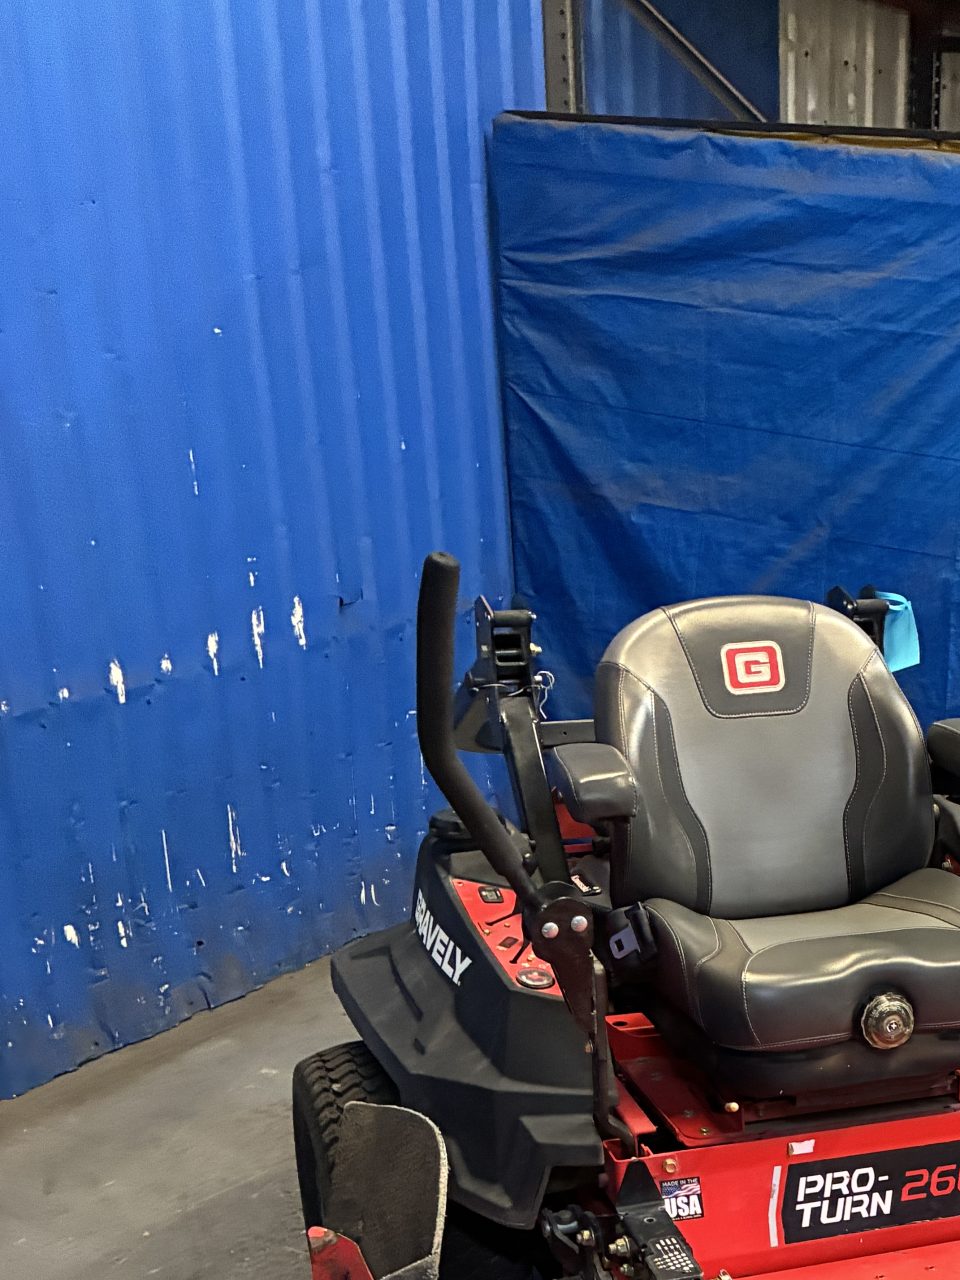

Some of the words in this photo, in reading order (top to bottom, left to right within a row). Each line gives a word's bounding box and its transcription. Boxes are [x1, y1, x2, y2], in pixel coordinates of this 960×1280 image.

[796, 1167, 889, 1202] PRO-
[664, 1195, 702, 1218] USA
[795, 1189, 893, 1227] TURN
